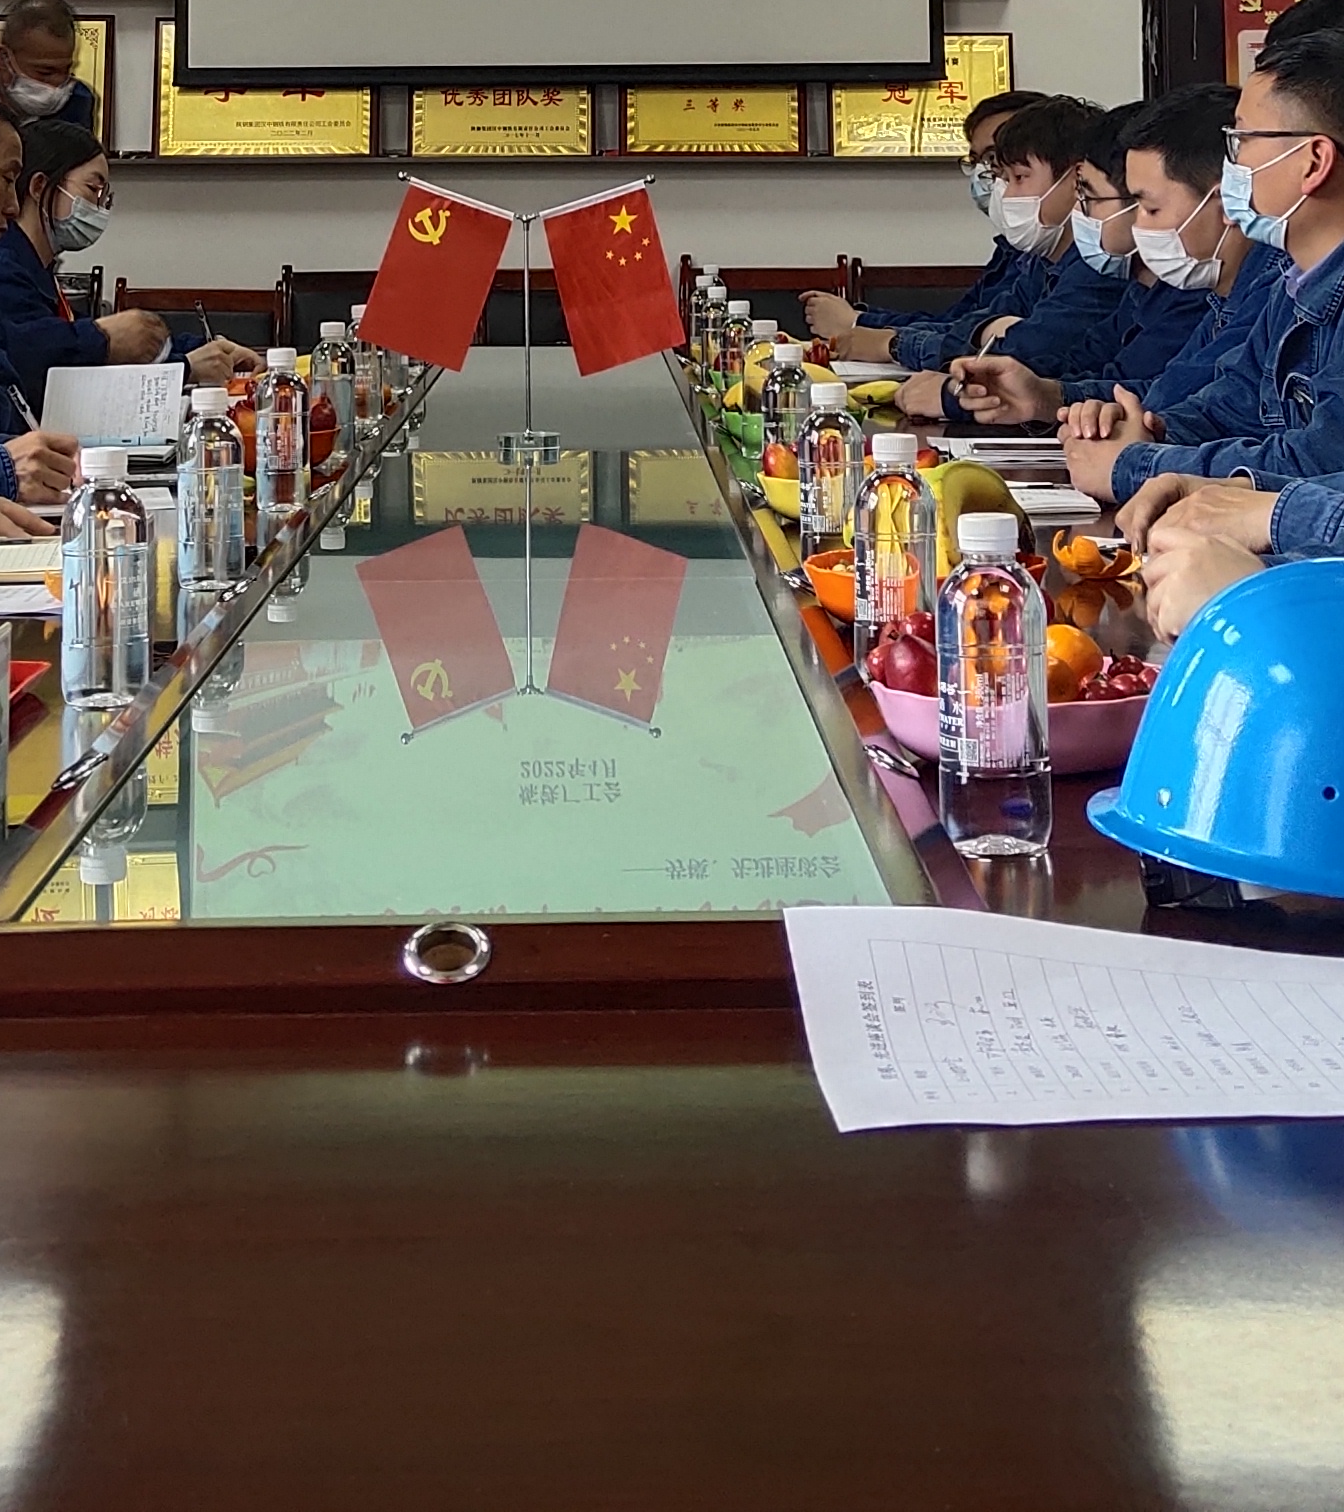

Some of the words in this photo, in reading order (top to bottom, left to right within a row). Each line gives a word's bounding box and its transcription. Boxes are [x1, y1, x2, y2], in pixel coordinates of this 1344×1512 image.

[440, 88, 564, 107] 优秀团队奖
[881, 81, 968, 105] 冠军
[683, 97, 746, 114] 三等奖
